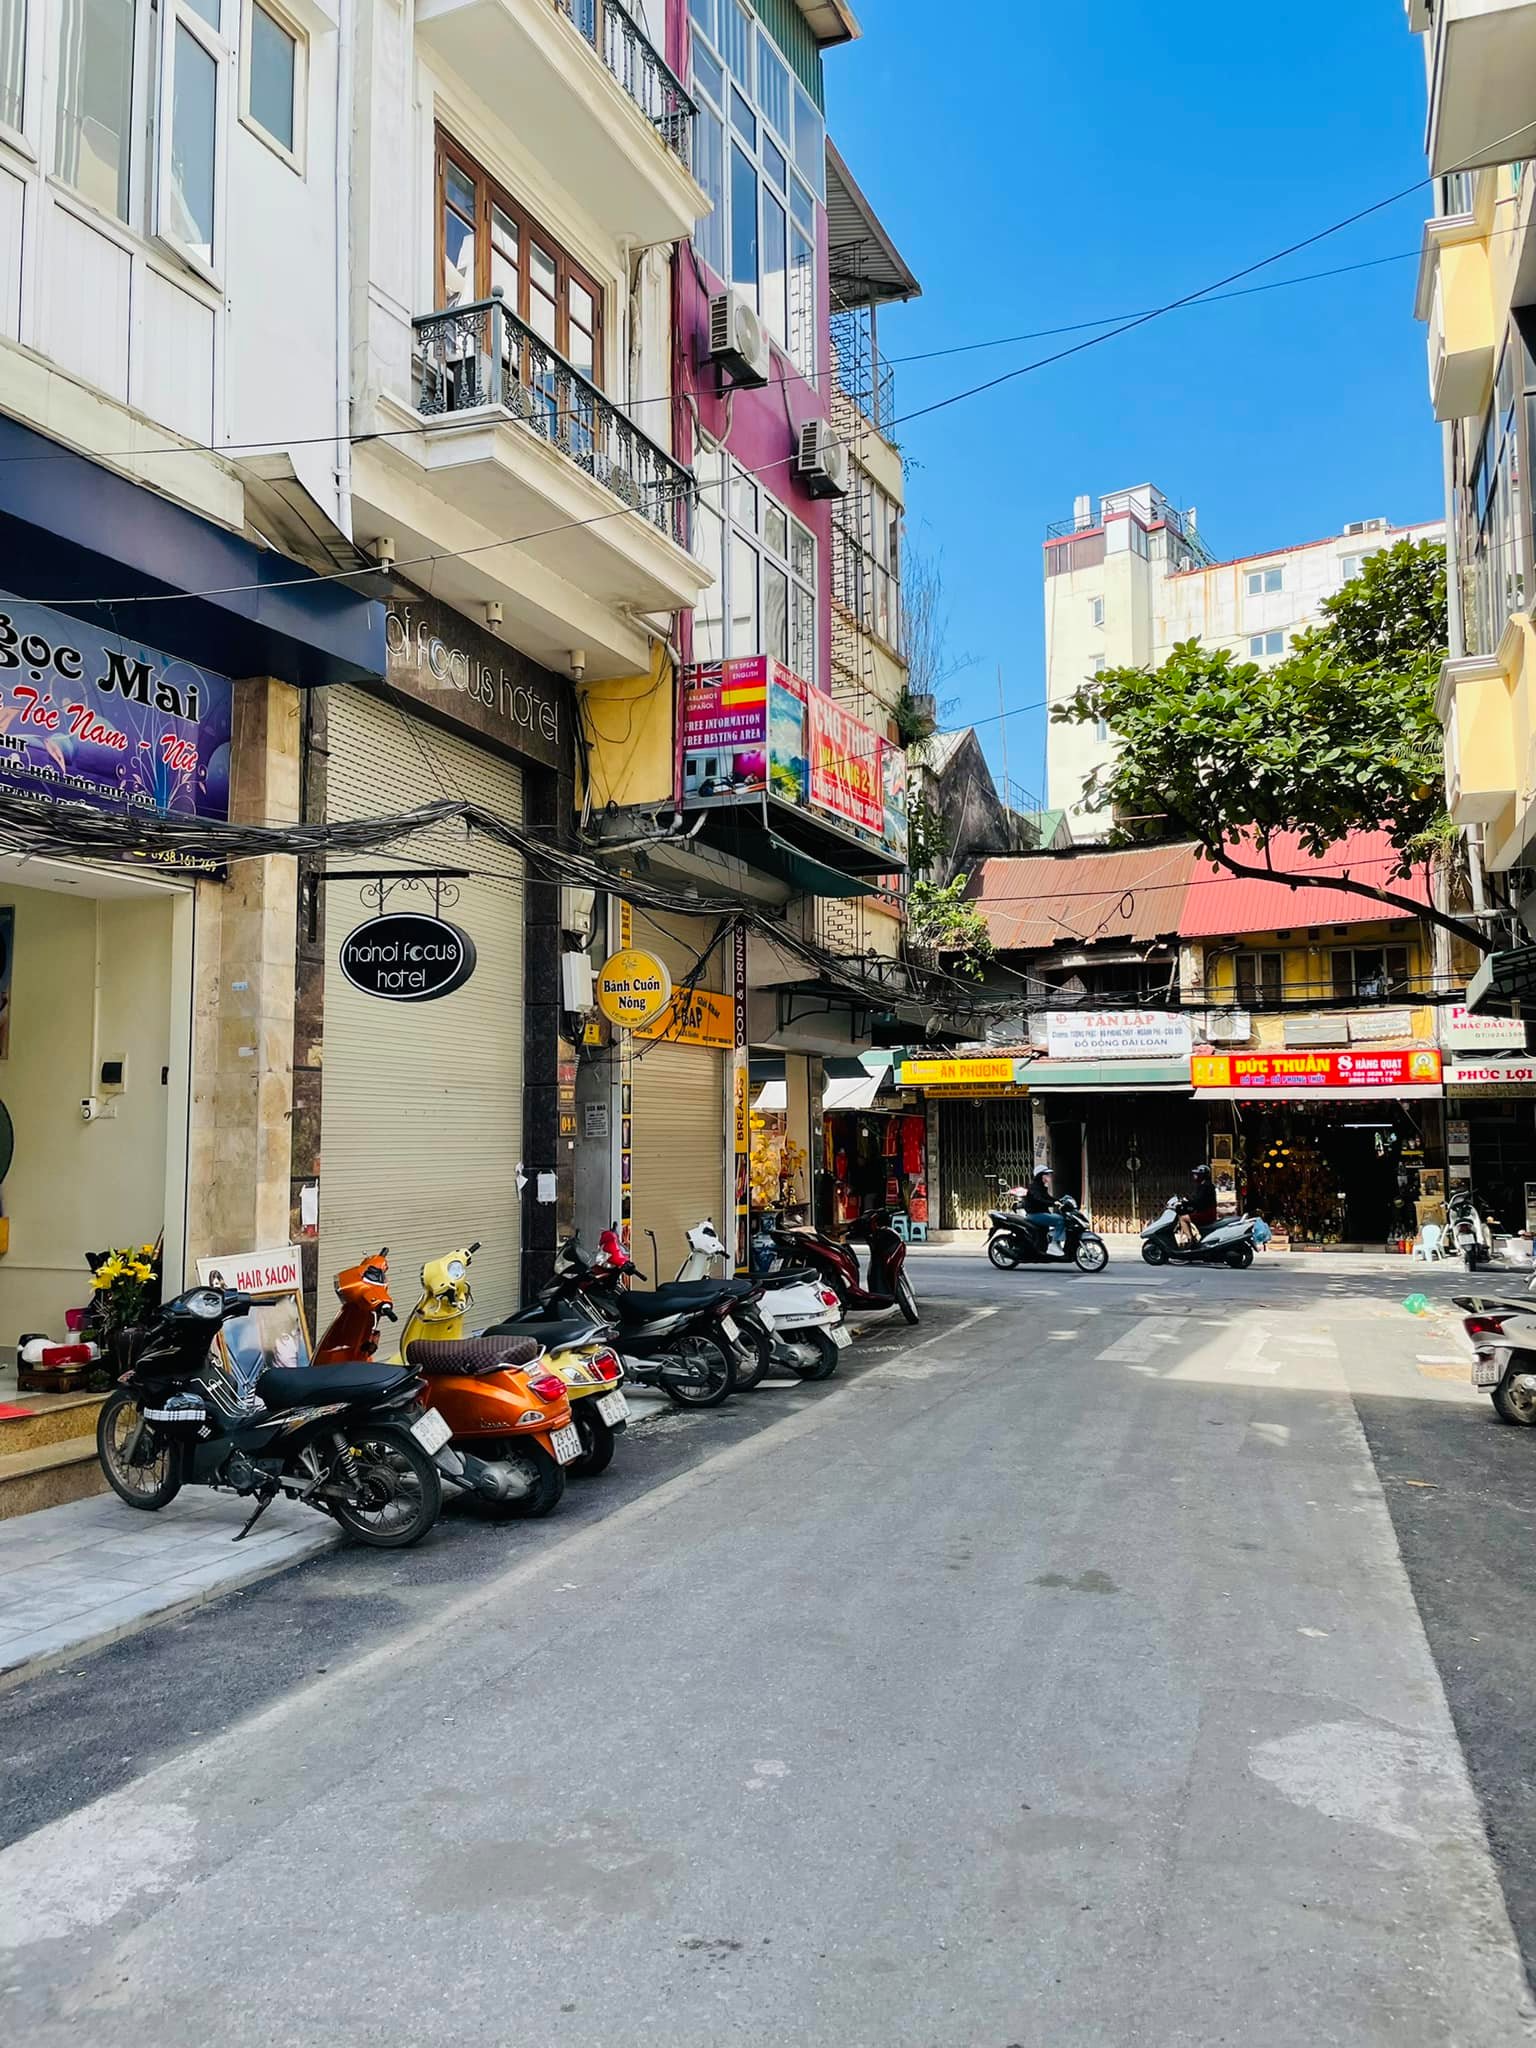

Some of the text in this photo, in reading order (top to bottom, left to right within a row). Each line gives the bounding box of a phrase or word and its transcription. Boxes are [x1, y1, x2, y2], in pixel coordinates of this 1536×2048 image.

[97, 648, 200, 722] Mai
[417, 621, 494, 708] focus
[500, 668, 559, 745] hotel
[732, 671, 759, 680] ENGLISH
[13, 686, 60, 730] Tóc
[67, 703, 129, 751] Nam
[160, 733, 200, 773] Nữ
[684, 713, 761, 733] FREE INFORMATION
[683, 727, 761, 747] FREE RESTING AREA
[348, 940, 457, 963] hanoi focus
[377, 968, 427, 989] hotel
[603, 975, 661, 993] Bánh Cuốn
[736, 926, 744, 1050] OOD & DRINKS
[618, 995, 646, 1011] Nóng
[1140, 1038, 1168, 1047] LOAN
[1235, 1057, 1269, 1074] ĐỨC
[1337, 1055, 1354, 1071] 8
[1355, 1057, 1379, 1070] HÀNG
[1457, 1067, 1533, 1081] PHÚC LỢI
[237, 1263, 297, 1291] HAIR SALON
